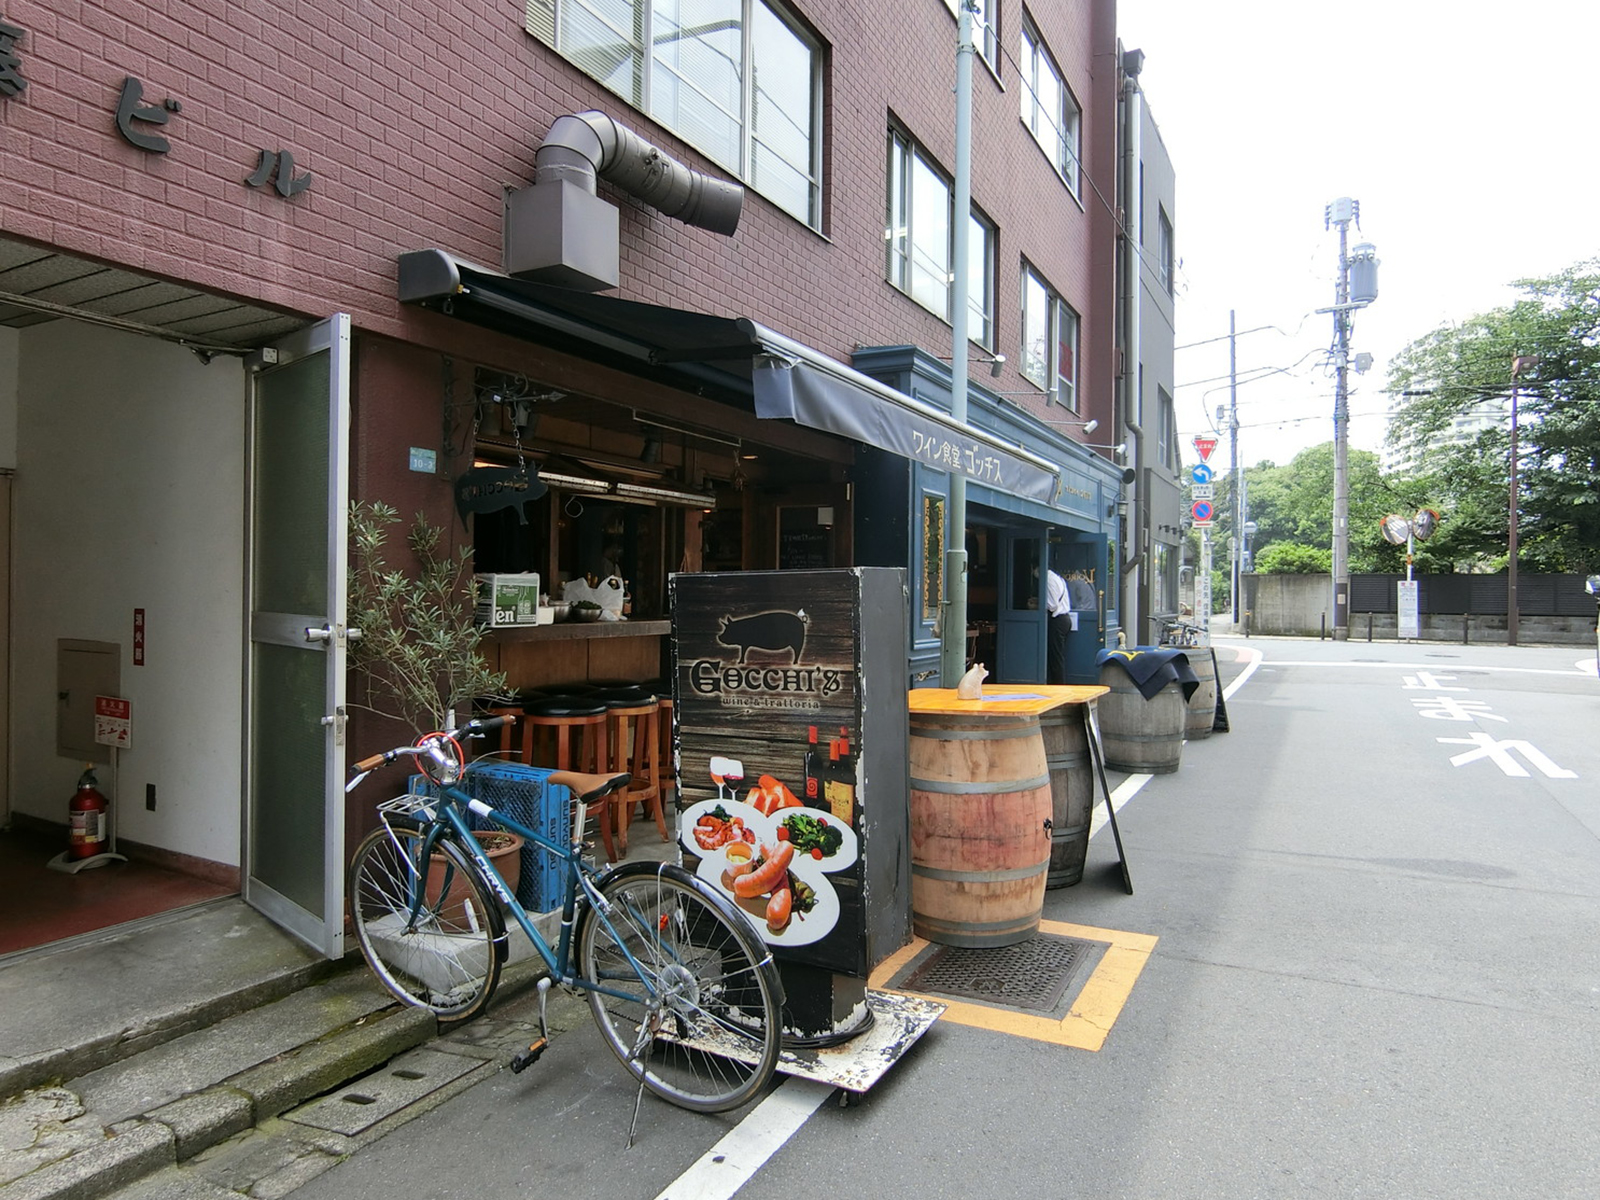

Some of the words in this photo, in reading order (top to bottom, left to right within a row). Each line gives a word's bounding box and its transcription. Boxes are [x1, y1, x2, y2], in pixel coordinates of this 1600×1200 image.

[913, 430, 961, 469] ワイン食堂
[965, 444, 1003, 484] ゴッチス
[691, 660, 841, 696] GOCCHI'S
[722, 695, 750, 706] wine
[753, 697, 760, 706] &
[764, 696, 820, 709] trattoria
[1401, 671, 1579, 779] 止まれ
